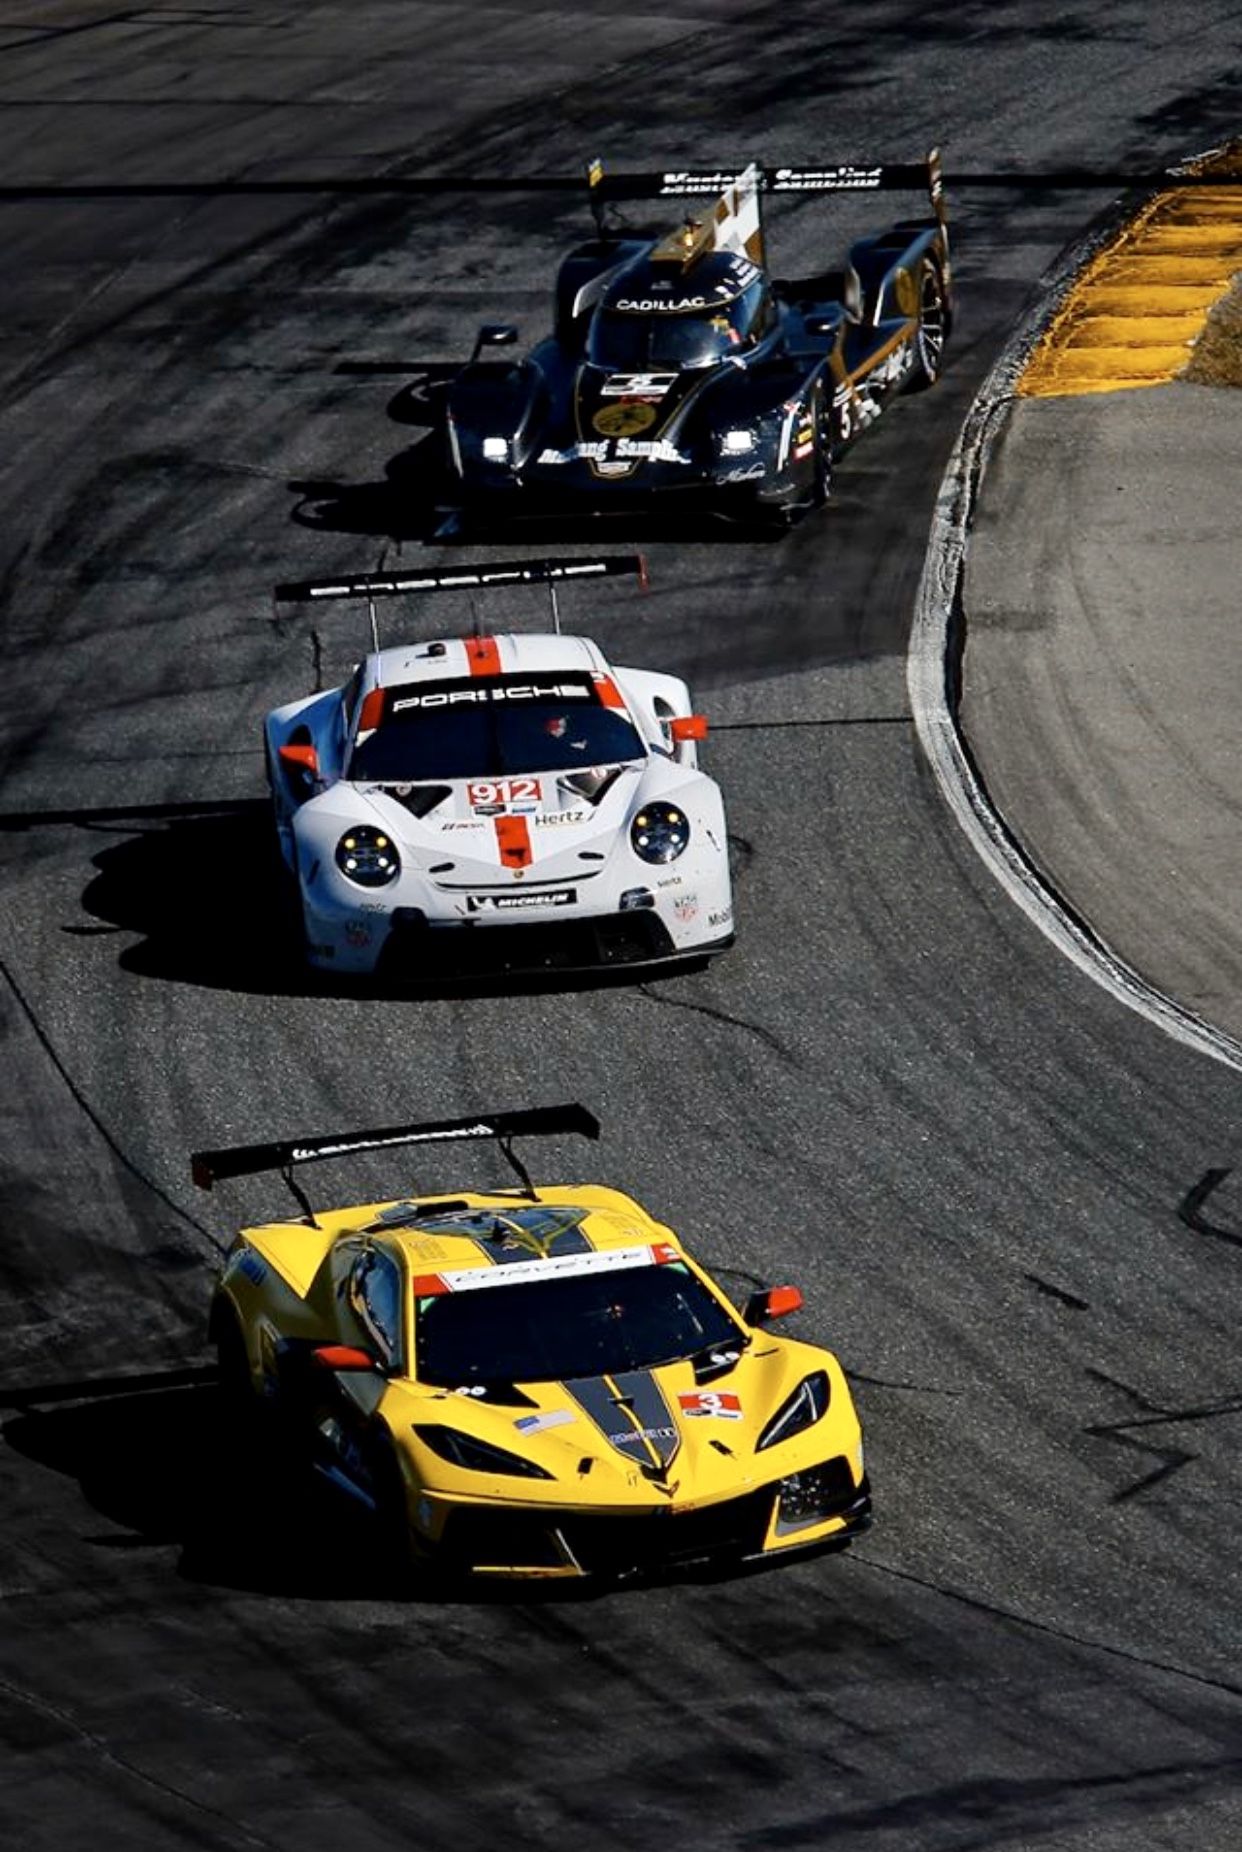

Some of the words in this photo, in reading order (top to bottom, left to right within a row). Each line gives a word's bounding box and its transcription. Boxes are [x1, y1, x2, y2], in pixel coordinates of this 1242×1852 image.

[616, 297, 705, 311] CADILLAC
[393, 685, 590, 712] PORSCHE
[471, 780, 538, 804] 912
[535, 811, 584, 826] Hertz
[498, 893, 569, 908] MICHELIN
[698, 1393, 722, 1410] 3
